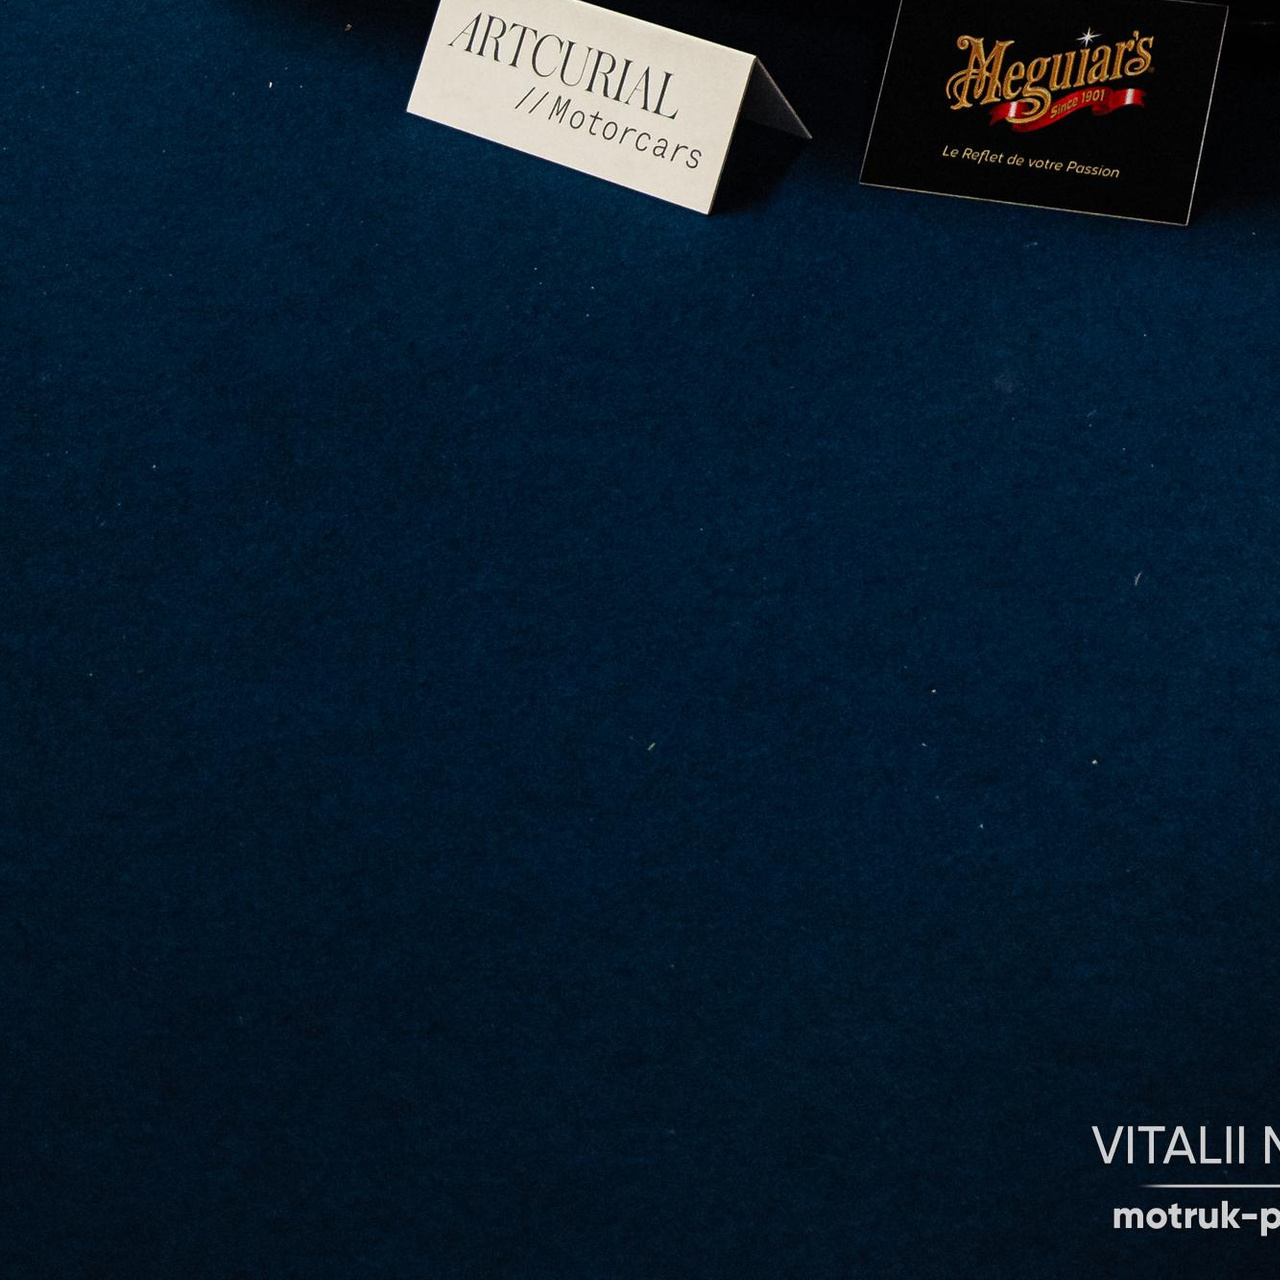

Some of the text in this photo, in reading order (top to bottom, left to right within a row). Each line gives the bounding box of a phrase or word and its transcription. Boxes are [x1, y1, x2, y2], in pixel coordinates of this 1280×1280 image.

[448, 11, 680, 120] ARTCURIAL
[946, 30, 1155, 124] Meguiar's
[1049, 88, 1106, 119] Since 1901
[514, 86, 702, 169] //Motorcars
[942, 145, 1121, 179] Le Reflet de votre Passion
